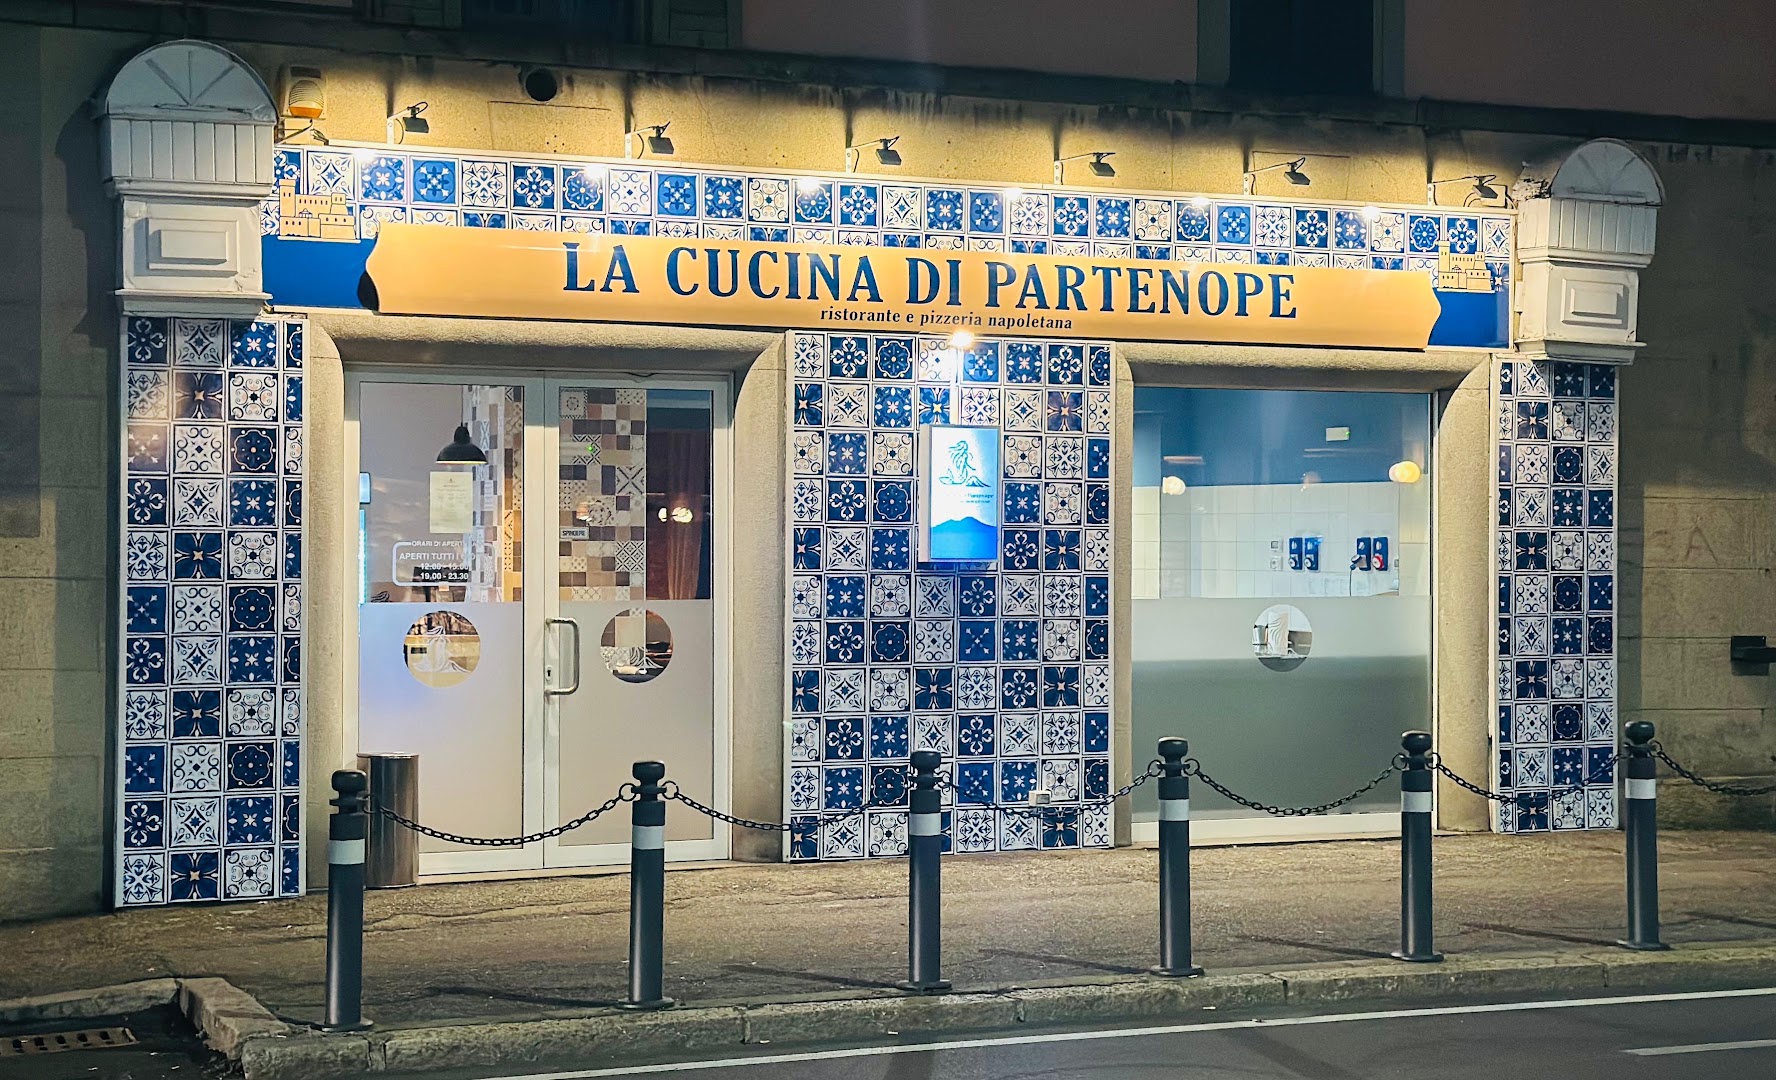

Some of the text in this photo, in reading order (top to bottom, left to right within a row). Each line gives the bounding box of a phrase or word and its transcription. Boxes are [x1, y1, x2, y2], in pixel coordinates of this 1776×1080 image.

[562, 241, 1298, 319] LA CUCINA DI PARTENOPE
[820, 306, 1073, 330] ristorante e pizzeria napoletana
[399, 552, 430, 561] APERTI
[431, 552, 455, 561] TUTTI
[448, 572, 469, 580] 23.30
